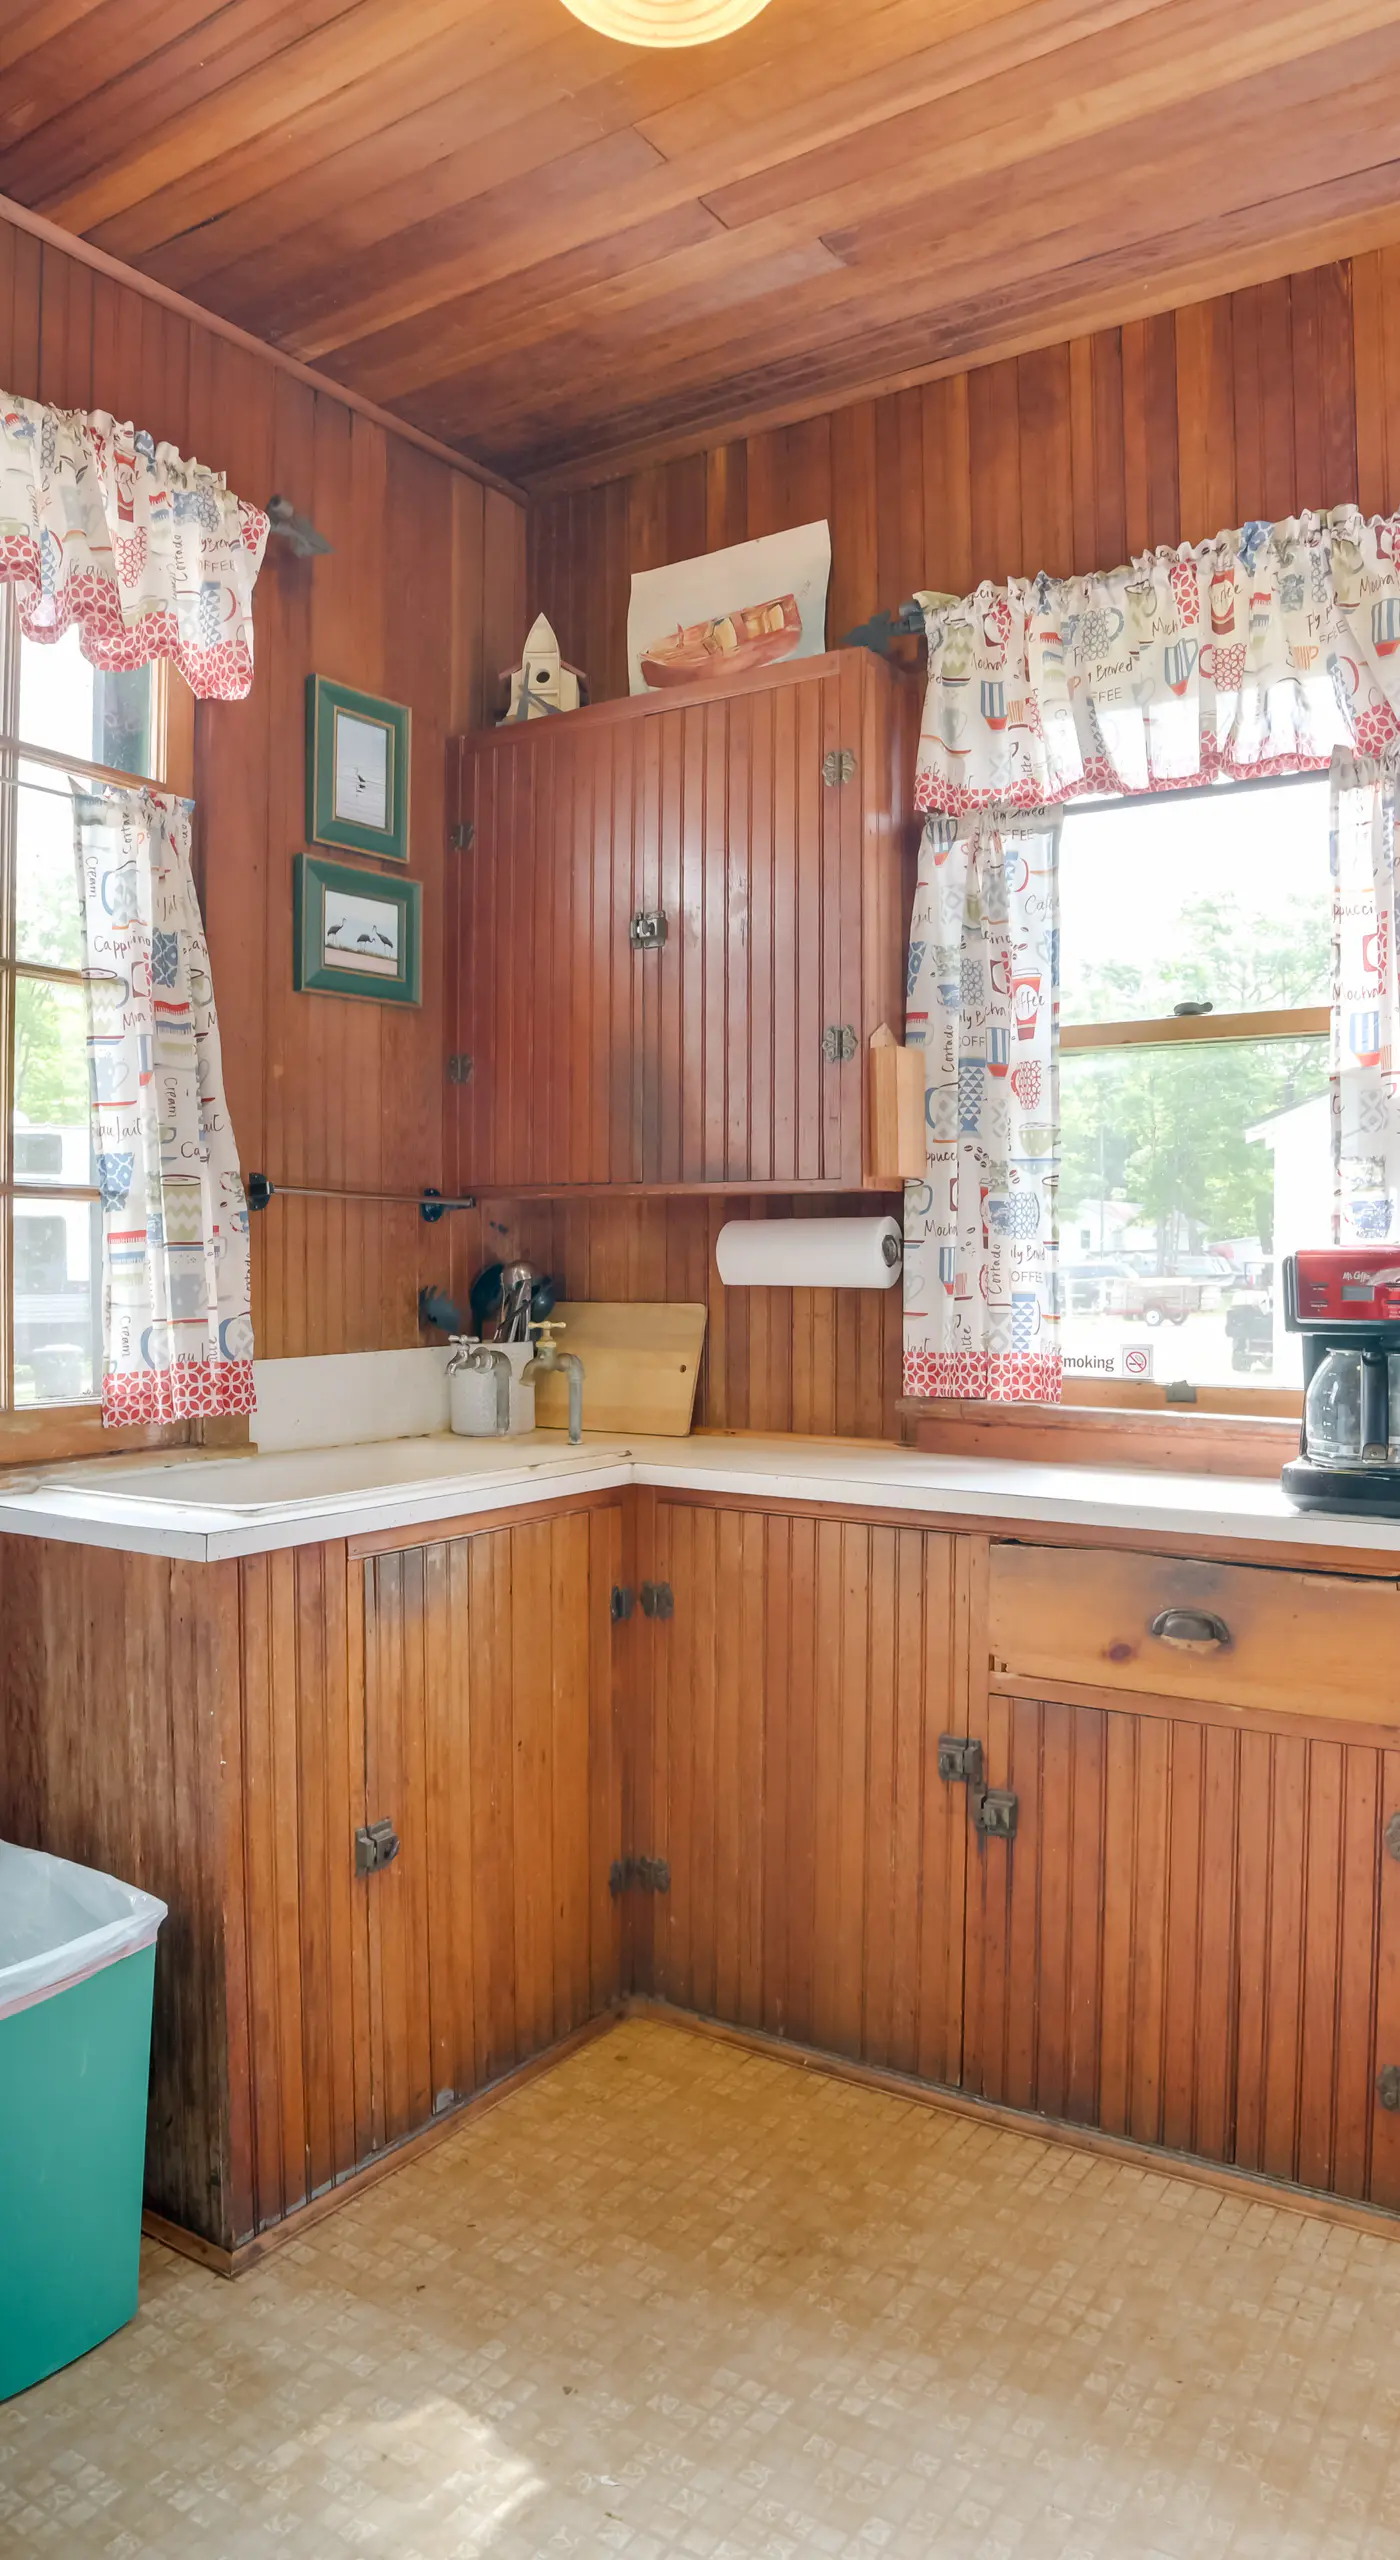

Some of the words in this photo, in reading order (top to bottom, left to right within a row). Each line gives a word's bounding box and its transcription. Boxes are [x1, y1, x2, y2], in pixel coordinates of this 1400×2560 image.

[1096, 656, 1134, 682] Brewed
[85, 856, 99, 898] Cream
[163, 1077, 178, 1118] Cream
[989, 1243, 1002, 1295] Cortado
[119, 1315, 131, 1357] Cream
[1063, 1354, 1115, 1373] moking
